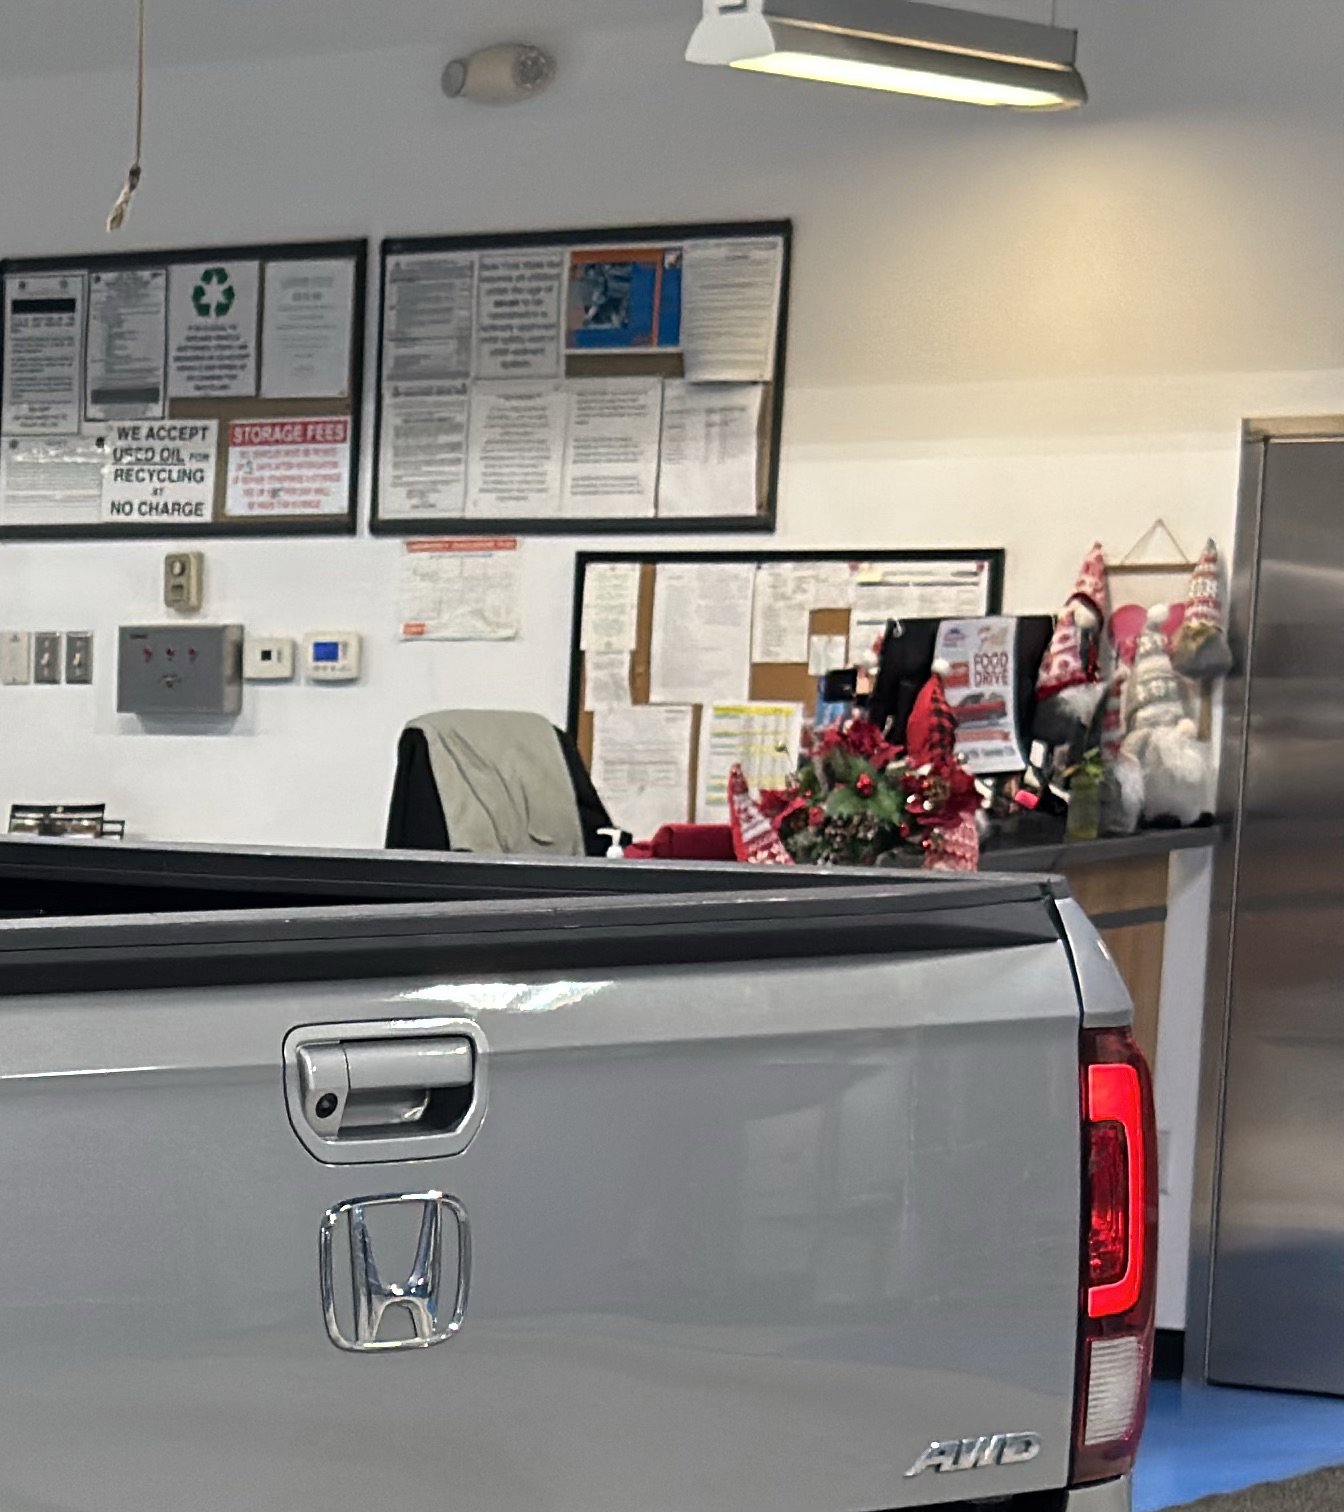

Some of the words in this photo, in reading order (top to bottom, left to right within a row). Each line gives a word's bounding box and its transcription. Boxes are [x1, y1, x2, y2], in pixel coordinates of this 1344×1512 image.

[117, 425, 141, 441] WE
[145, 424, 210, 441] ACCEPT
[233, 424, 305, 445] STORAGE
[306, 422, 345, 442] FEES
[112, 446, 156, 463] USED
[159, 446, 185, 463] OIL
[113, 467, 205, 484] RECYCLING
[110, 500, 133, 517] NO
[137, 501, 206, 518] CHARGE
[973, 651, 1009, 671] FOOD
[973, 669, 1009, 688] DRIVE
[903, 1431, 1042, 1478] AWD
